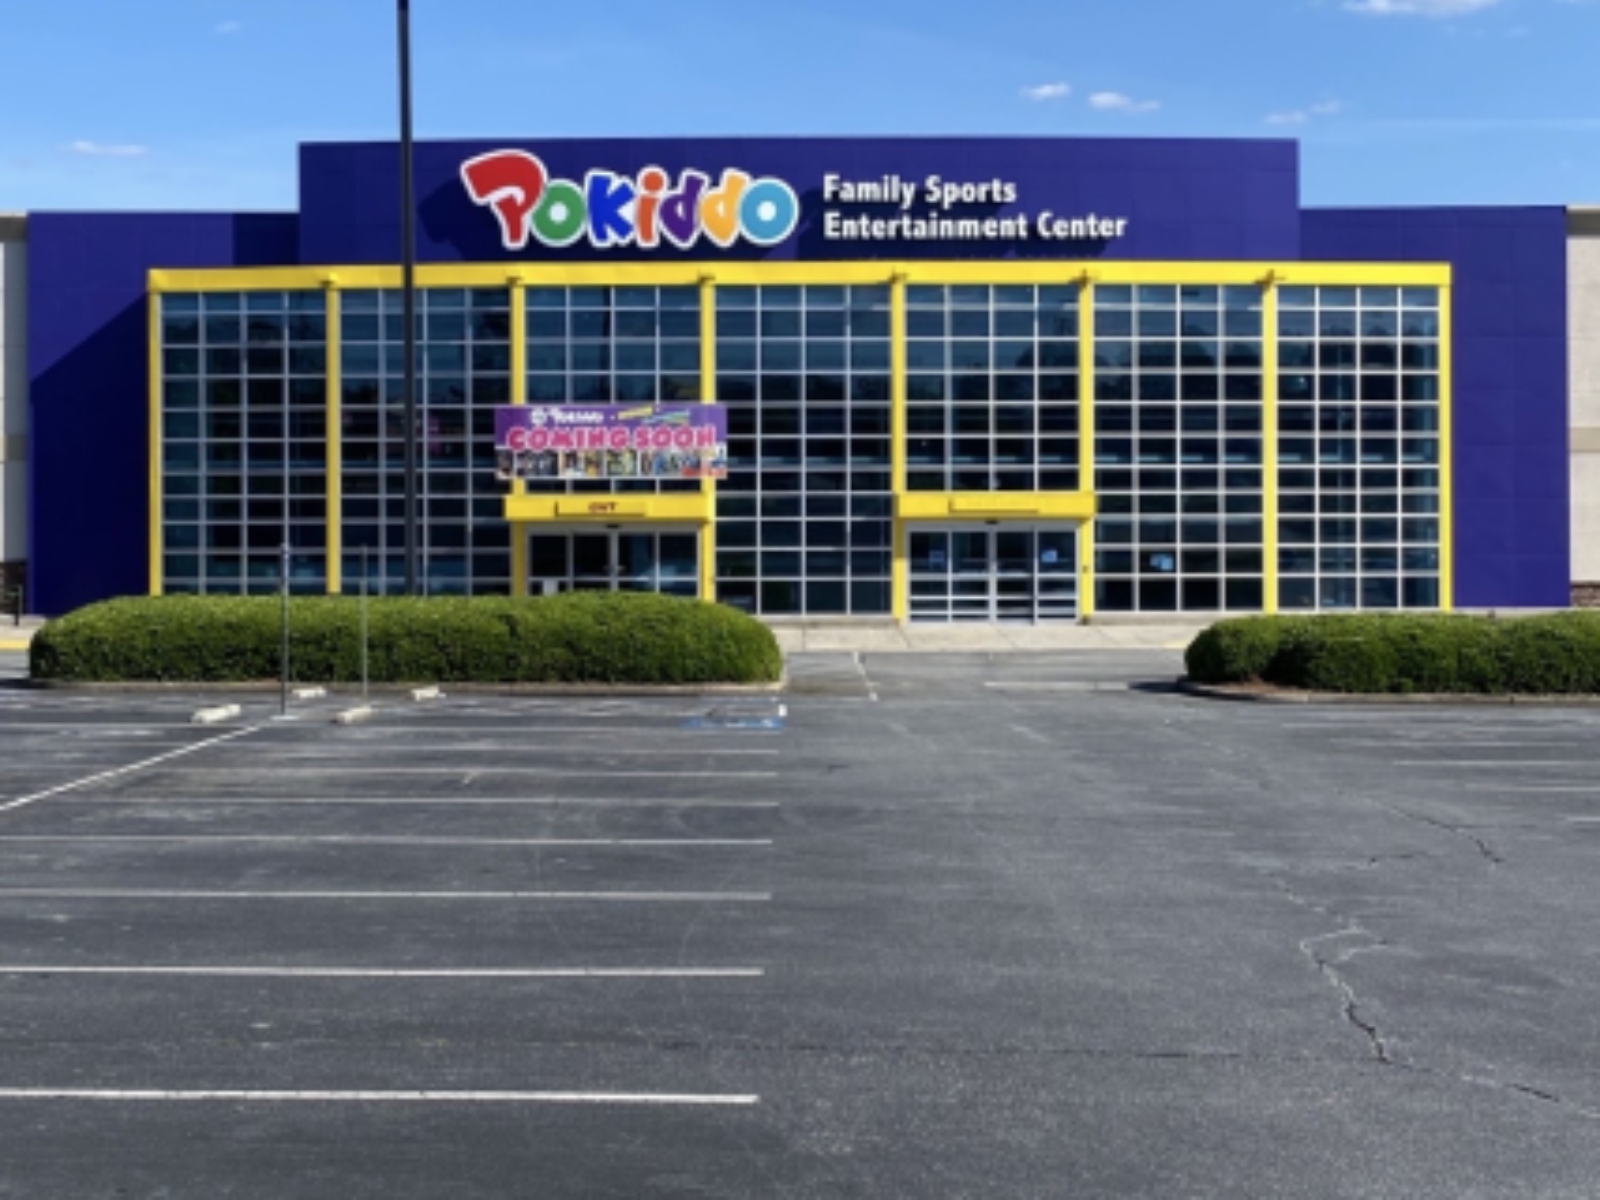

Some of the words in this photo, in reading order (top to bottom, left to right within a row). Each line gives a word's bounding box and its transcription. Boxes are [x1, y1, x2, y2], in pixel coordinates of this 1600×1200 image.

[823, 172, 916, 209] Family
[925, 173, 1018, 209] Sports
[823, 210, 1028, 240] Entertainment
[1037, 210, 1128, 239] Center
[507, 426, 630, 451] COMING
[633, 425, 716, 450] SOON
